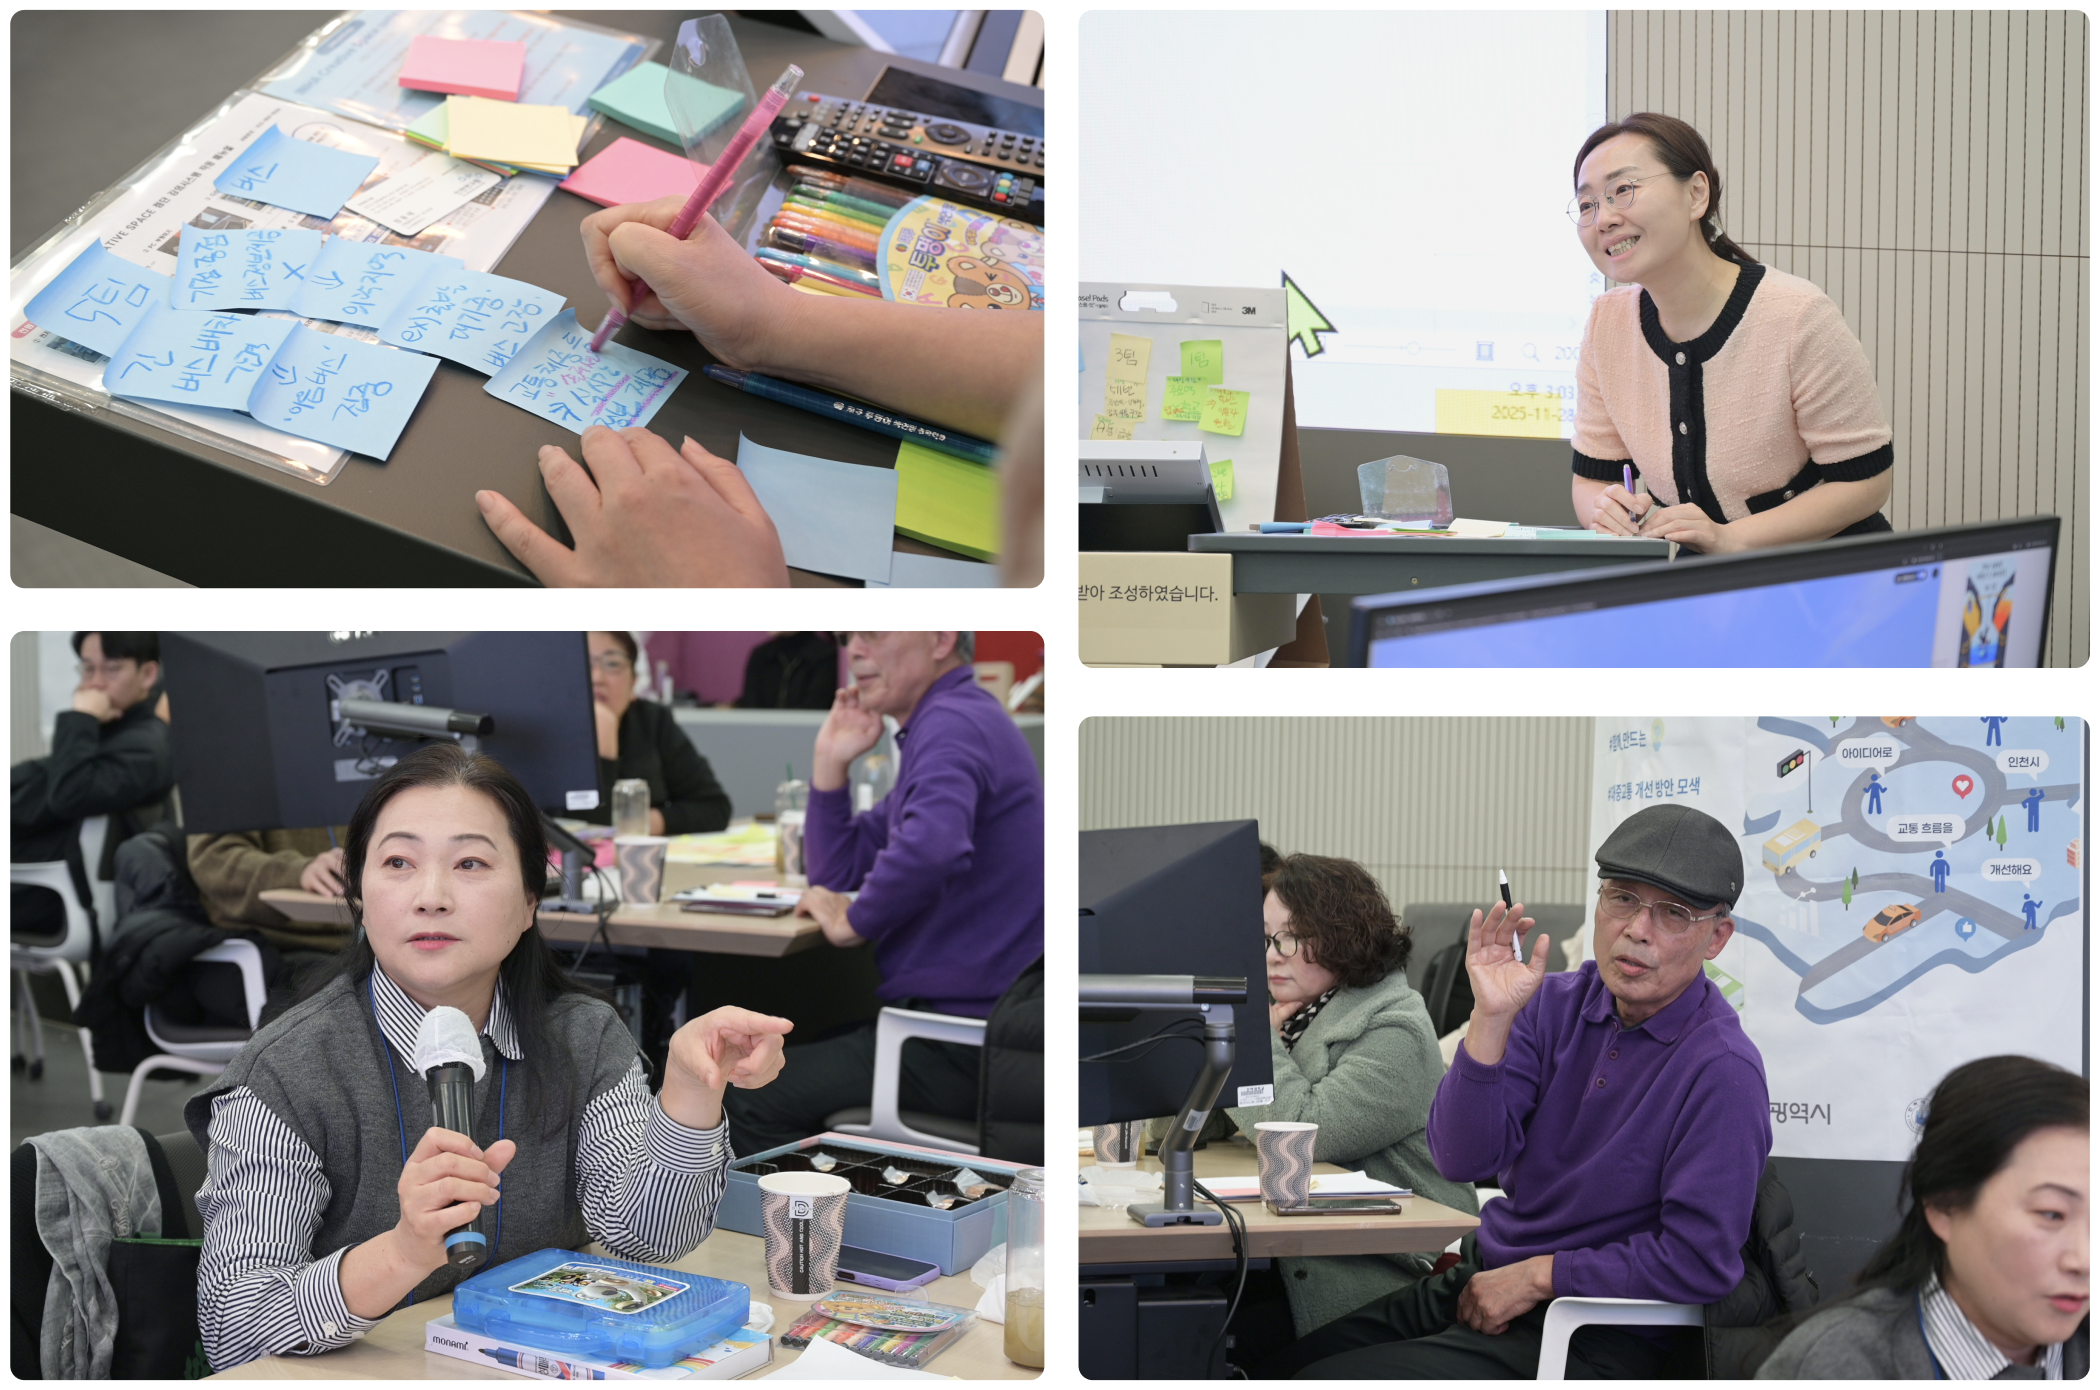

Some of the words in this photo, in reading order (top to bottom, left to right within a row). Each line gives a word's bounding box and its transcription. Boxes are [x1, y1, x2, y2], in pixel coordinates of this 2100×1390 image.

[230, 163, 279, 191] 버스
[127, 209, 156, 232] SPACE
[908, 222, 951, 273] 투명이
[65, 277, 150, 325] 5팀
[1092, 294, 1109, 302] Pads
[1241, 306, 1256, 315] 3M
[482, 339, 519, 368] 버스
[1115, 347, 1138, 366] 3팀
[1190, 351, 1209, 368] 1팀
[1508, 382, 1539, 399] 오후
[1545, 385, 1575, 400] 3:03
[1491, 405, 1575, 422] 2025-11-28
[1078, 584, 1105, 601] 받아
[1108, 585, 1218, 602] 조성하였습니다.
[1842, 747, 1893, 759] 아이디어로
[2008, 756, 2040, 768] 인천시
[1635, 780, 1653, 799] 개선
[1655, 778, 1674, 798] 방안
[1677, 776, 1700, 796] 모색
[1897, 822, 1919, 834] 교통
[1921, 822, 1953, 834] 흐름을
[1990, 864, 2032, 876] 개선해요
[1769, 1102, 1831, 1125] 광역시
